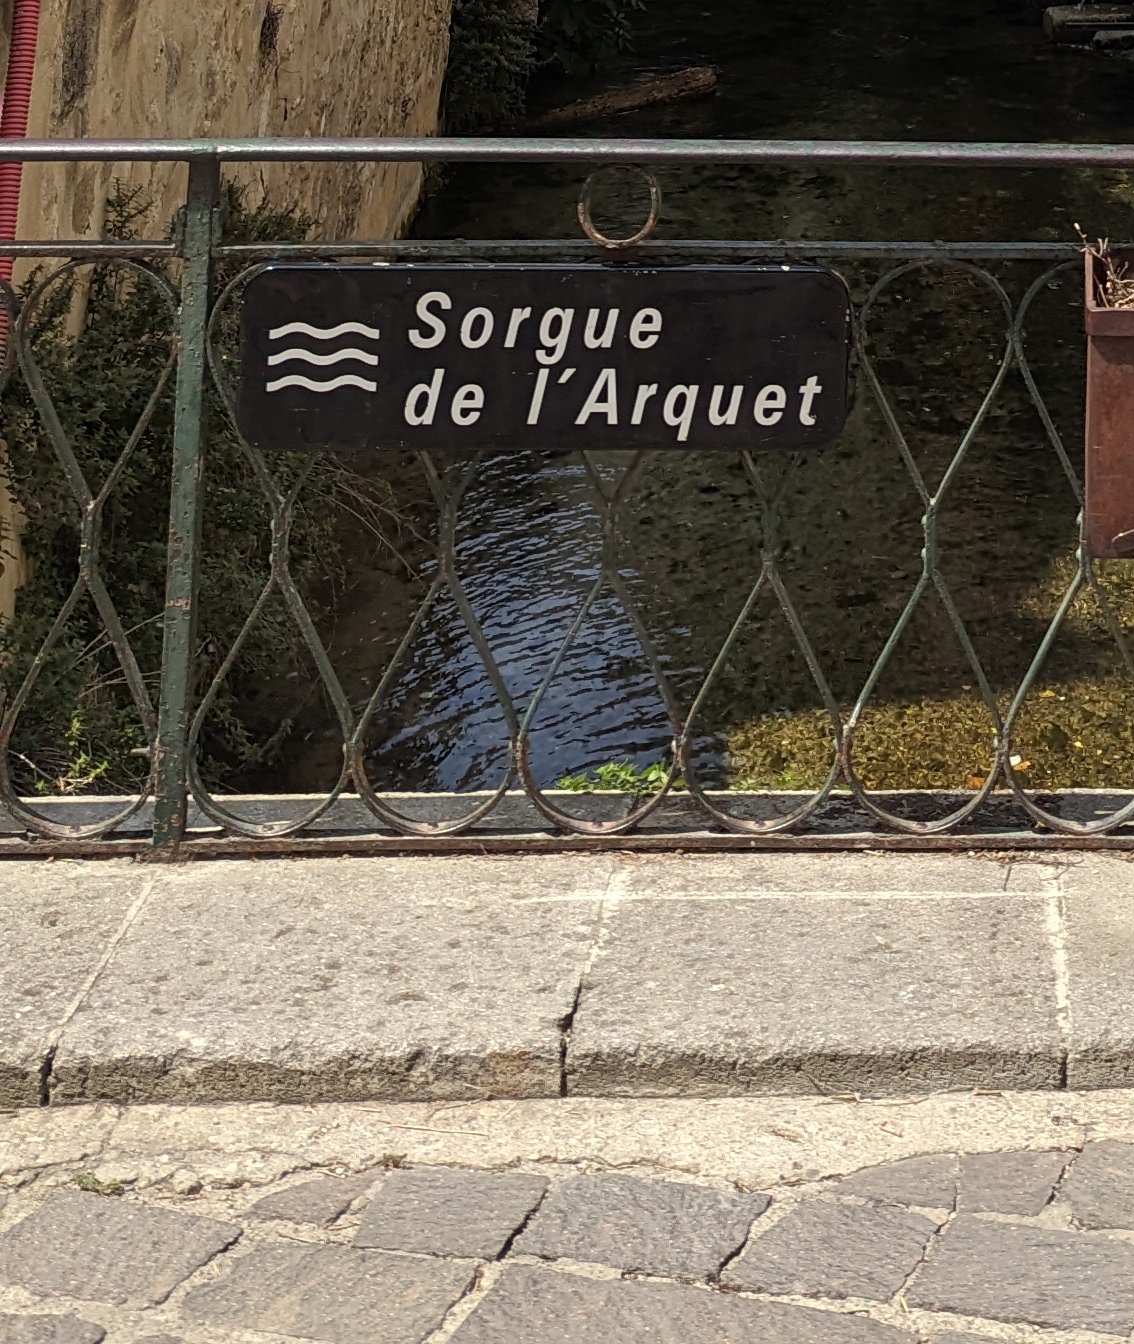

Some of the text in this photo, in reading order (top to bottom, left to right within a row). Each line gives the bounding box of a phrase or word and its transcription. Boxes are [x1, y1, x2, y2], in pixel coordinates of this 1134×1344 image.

[408, 291, 664, 366] Sorgue
[403, 368, 823, 442] de l'Arquet
